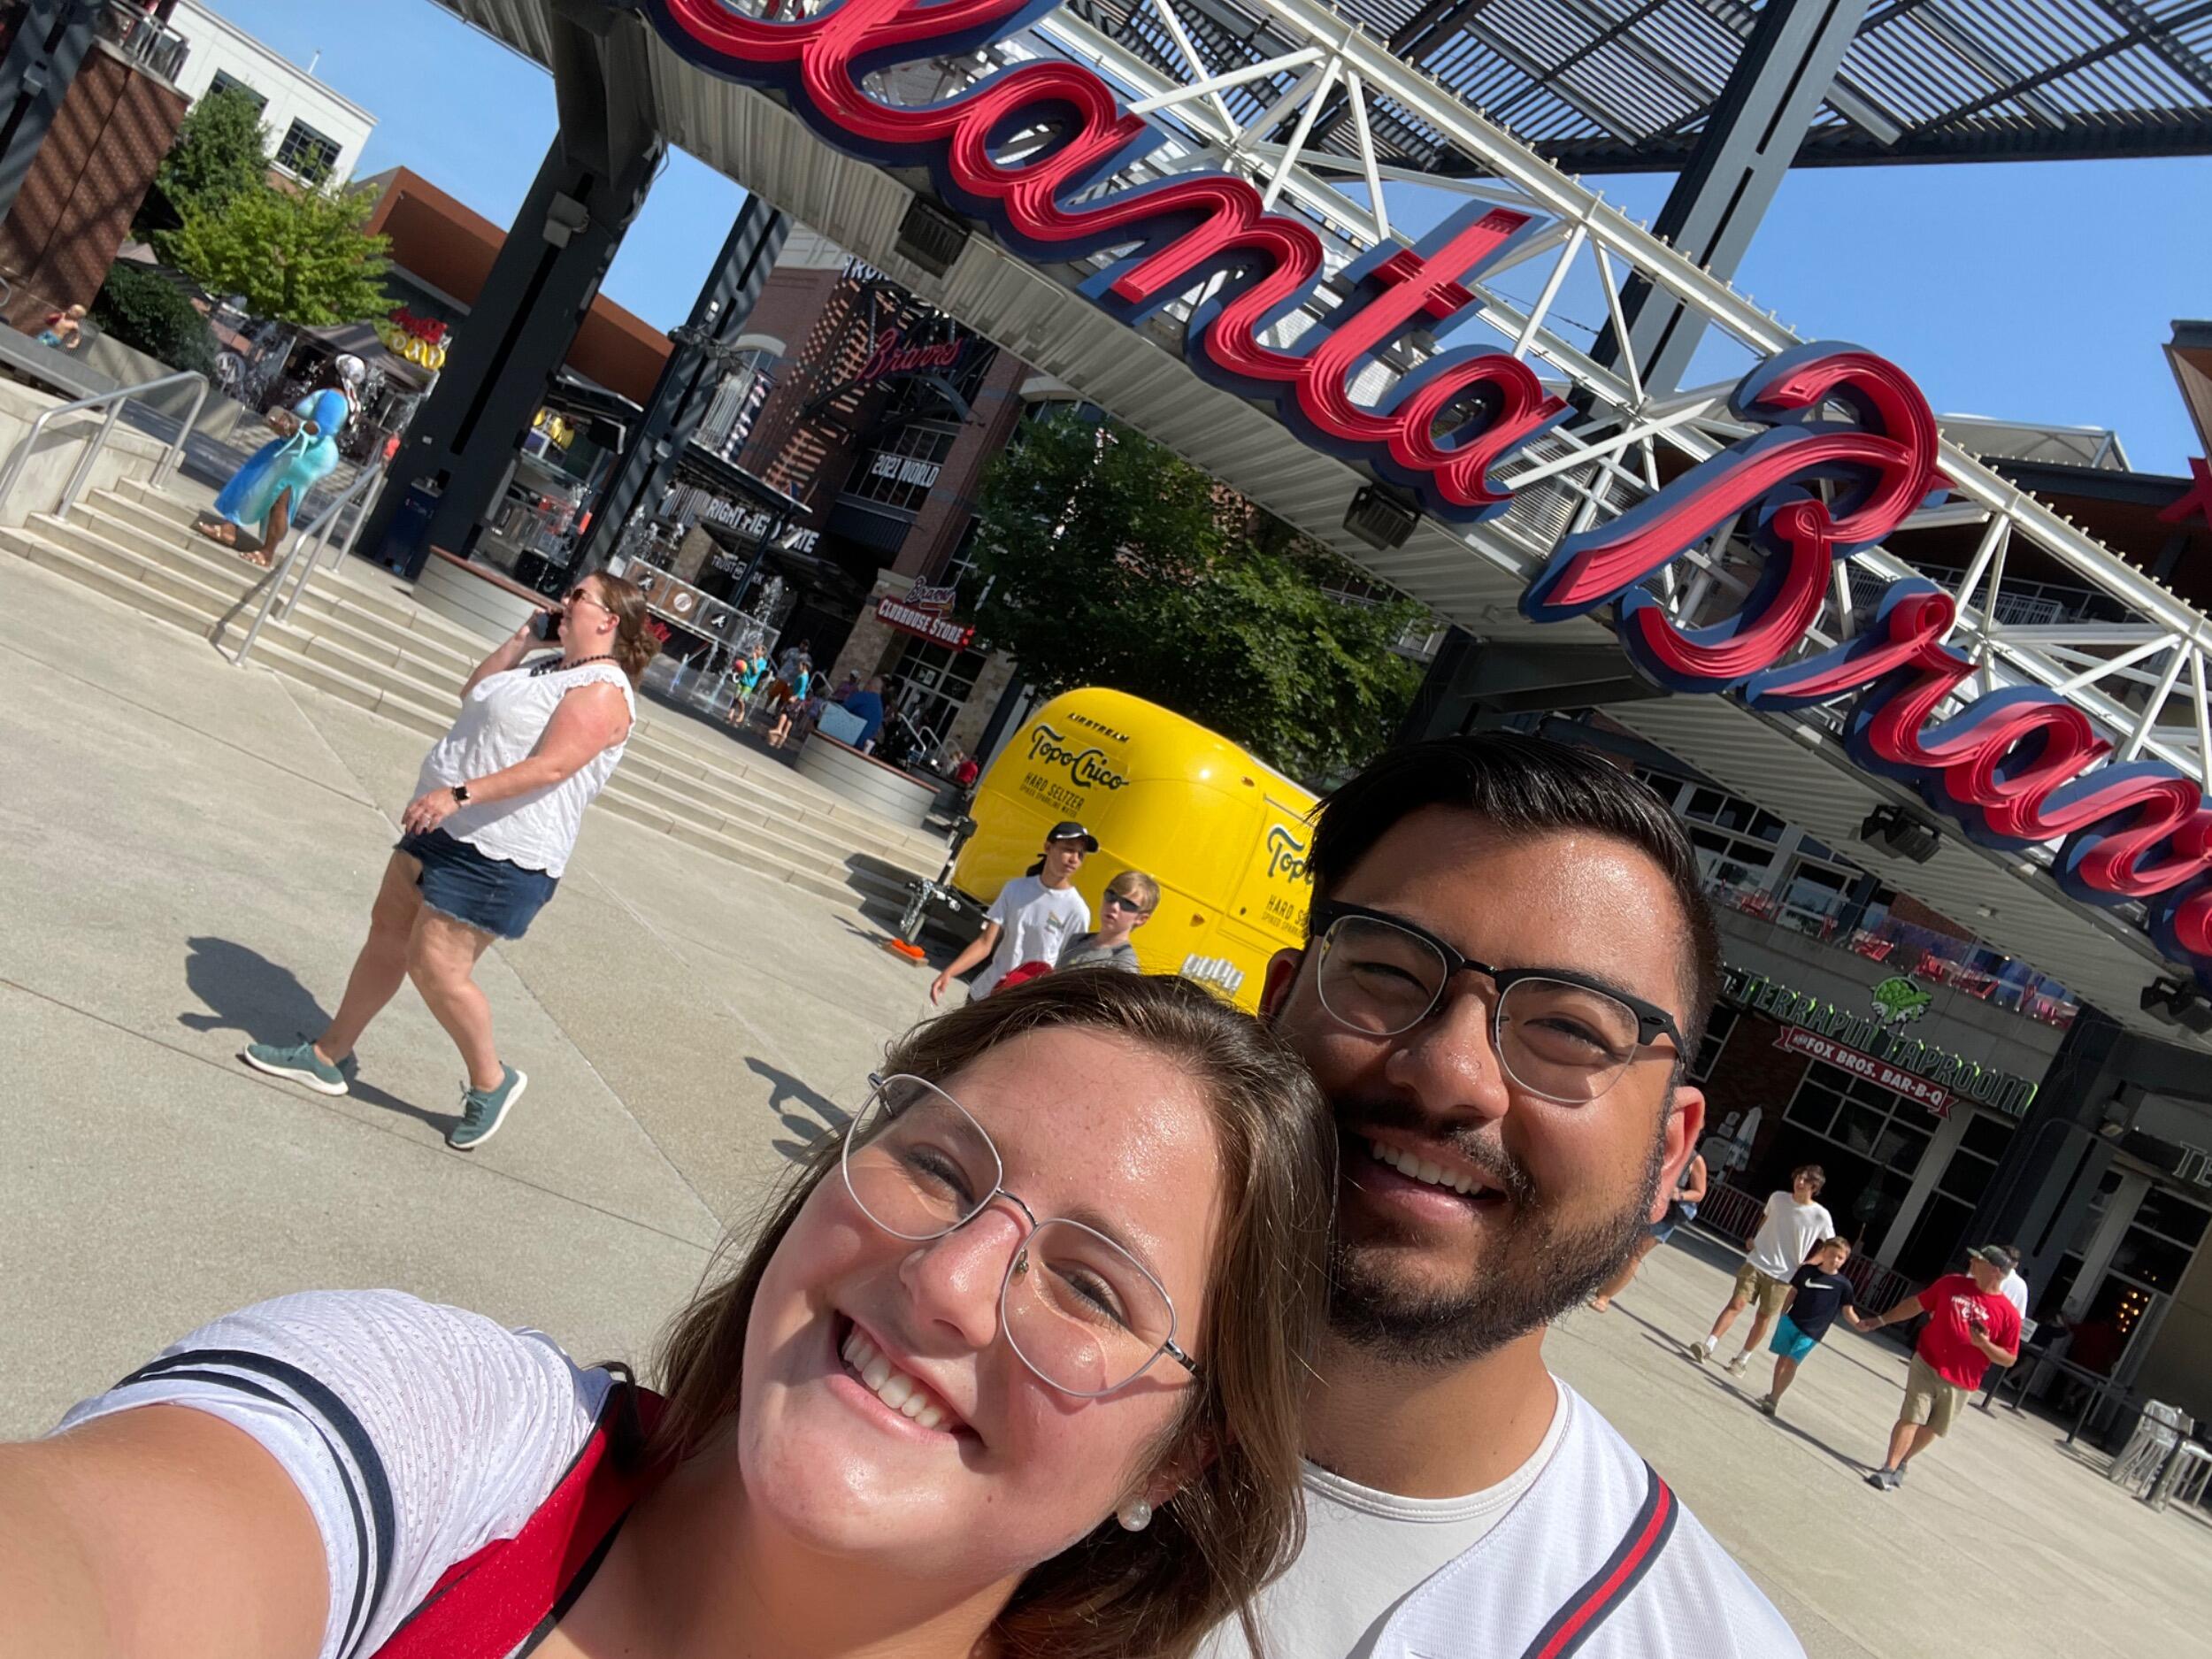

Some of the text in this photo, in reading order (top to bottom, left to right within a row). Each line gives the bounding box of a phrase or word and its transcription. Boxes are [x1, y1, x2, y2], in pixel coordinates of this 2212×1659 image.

[855, 326, 963, 381] Braves
[872, 455, 942, 488] 2021 WORLD
[707, 498, 746, 530] RIGHT
[878, 599, 964, 645] CLUBHOUSE STORE
[1067, 712, 1130, 743] AIRSTREAM
[1027, 724, 1130, 790] Topo Chico
[1024, 772, 1086, 811] HARD SELTZER
[1265, 894, 1294, 920] HARD
[1736, 972, 2039, 1116] TERRAPIN TAPROOM
[1805, 1037, 1833, 1059] FOX
[1835, 1050, 1876, 1079] BROS.
[1880, 1069, 1944, 1107] BAR-B-Q
